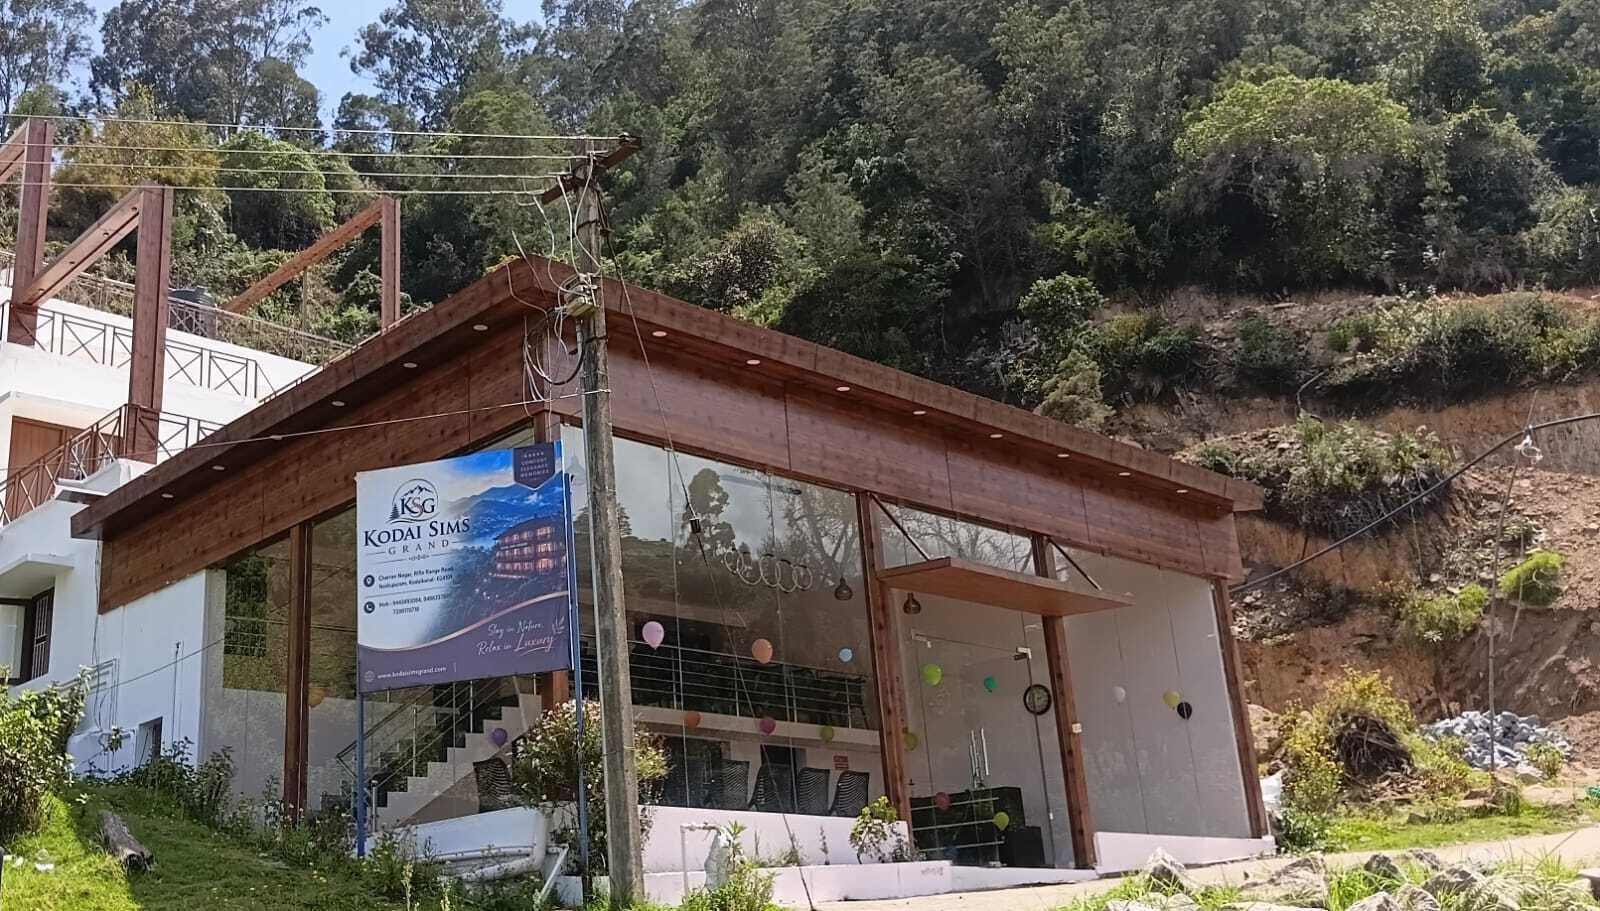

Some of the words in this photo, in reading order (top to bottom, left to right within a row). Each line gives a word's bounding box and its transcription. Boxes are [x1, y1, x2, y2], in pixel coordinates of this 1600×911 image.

[400, 497, 435, 518] KSG
[388, 539, 450, 555] GRAND
[488, 623, 504, 639] Stay
[476, 640, 501, 656] Relax
[513, 633, 554, 653] Luxury
